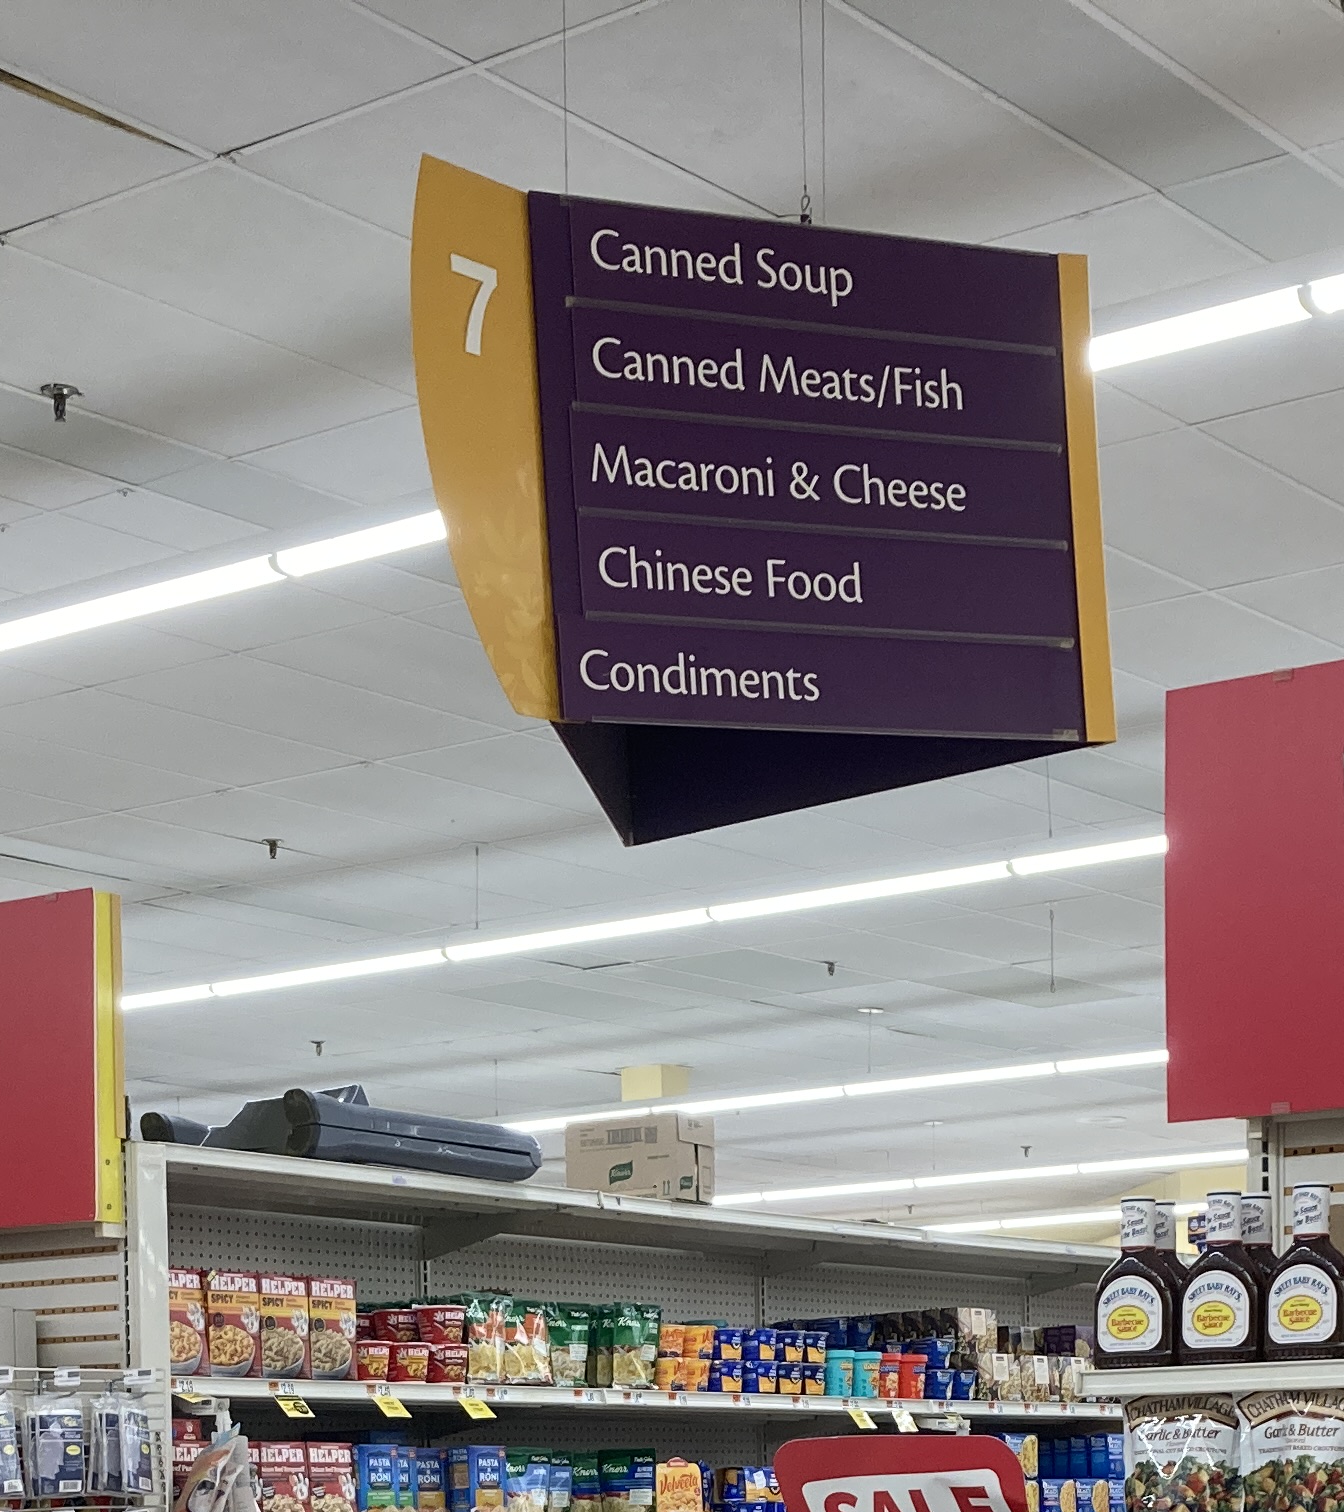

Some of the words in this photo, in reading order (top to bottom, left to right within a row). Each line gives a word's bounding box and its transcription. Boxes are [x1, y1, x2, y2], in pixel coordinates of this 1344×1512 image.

[590, 229, 744, 286] Canned
[756, 250, 854, 306] Soup
[450, 253, 497, 356] 7
[592, 338, 745, 391] Canned
[759, 353, 964, 411] Meats/Fish
[591, 442, 775, 498] Macaroni
[790, 462, 820, 501] &
[833, 463, 967, 511] Cheese
[598, 546, 752, 598] Chinese
[766, 559, 863, 603] Food
[579, 649, 820, 702] Condiments
[210, 1276, 256, 1292] HELPER
[262, 1280, 306, 1295] HELPER
[311, 1282, 354, 1298] HELPER
[211, 1293, 233, 1304] SPICY
[262, 1297, 284, 1308] SPICY
[312, 1300, 333, 1310] SPICY
[1298, 1425, 1340, 1437] Butter
[658, 1473, 699, 1492] Velveeta
